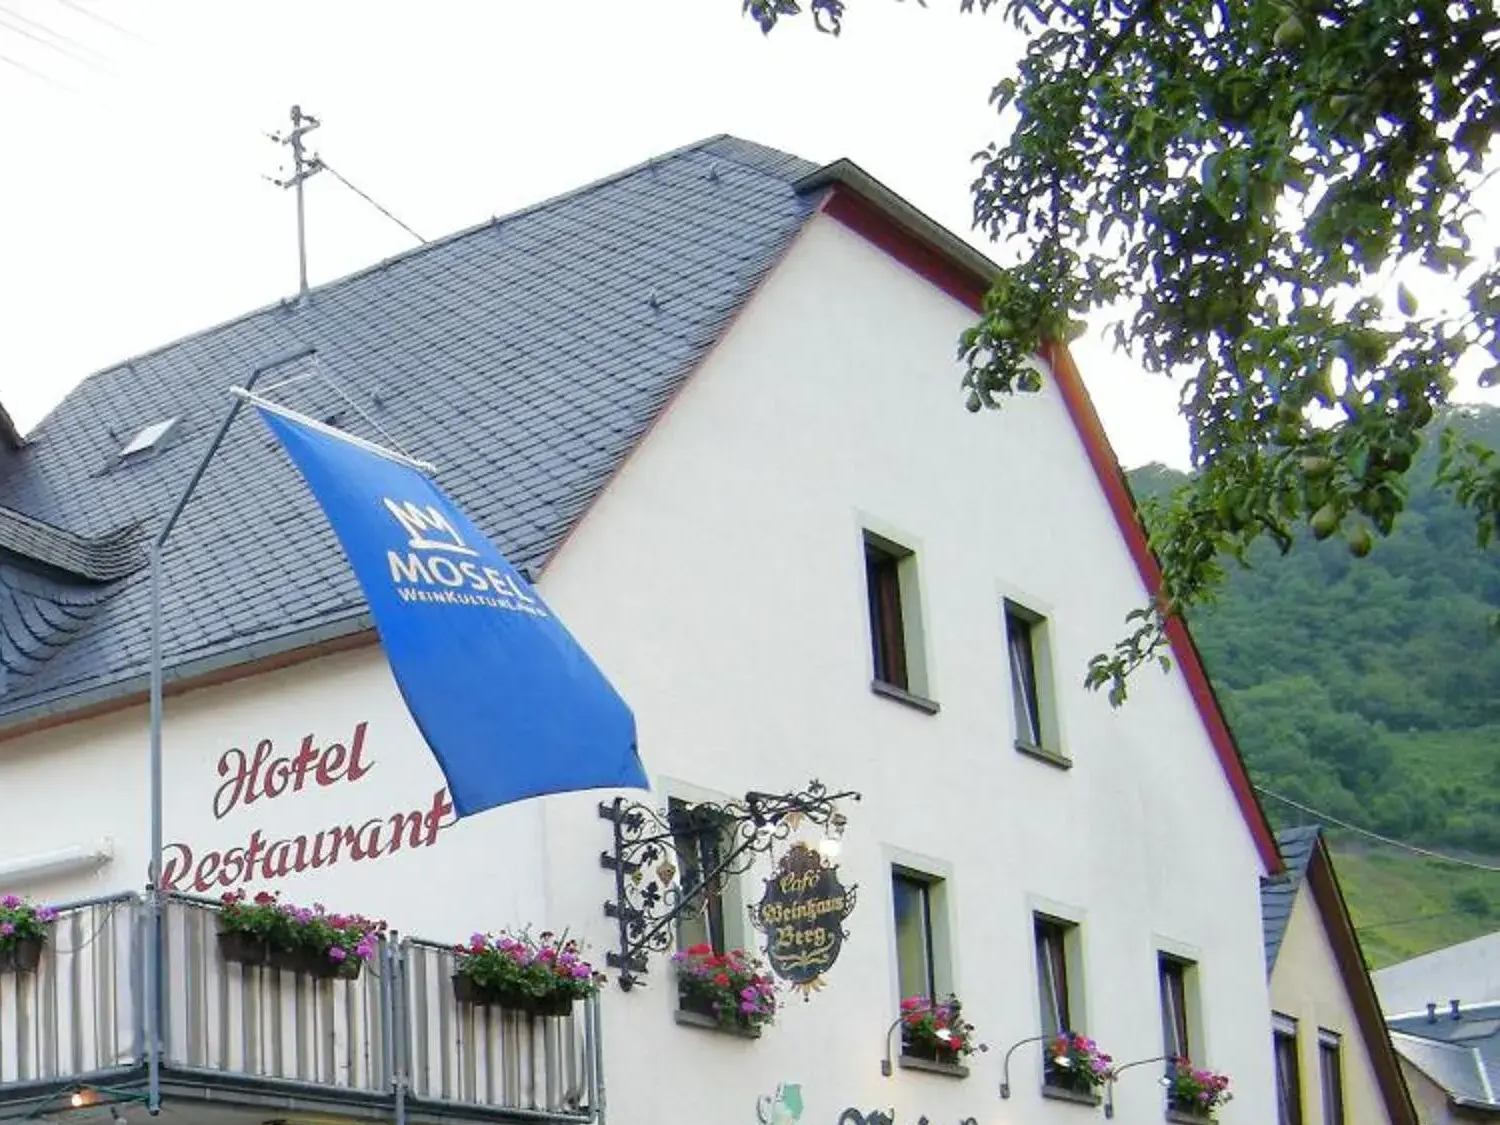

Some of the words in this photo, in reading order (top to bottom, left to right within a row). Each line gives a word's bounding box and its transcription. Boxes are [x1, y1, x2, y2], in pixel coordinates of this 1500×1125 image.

[387, 550, 535, 604] MOSEL
[213, 720, 376, 820] Hotel
[149, 787, 460, 893] Restaurant
[761, 897, 845, 924] Weinhaus
[775, 924, 827, 948] Berg
